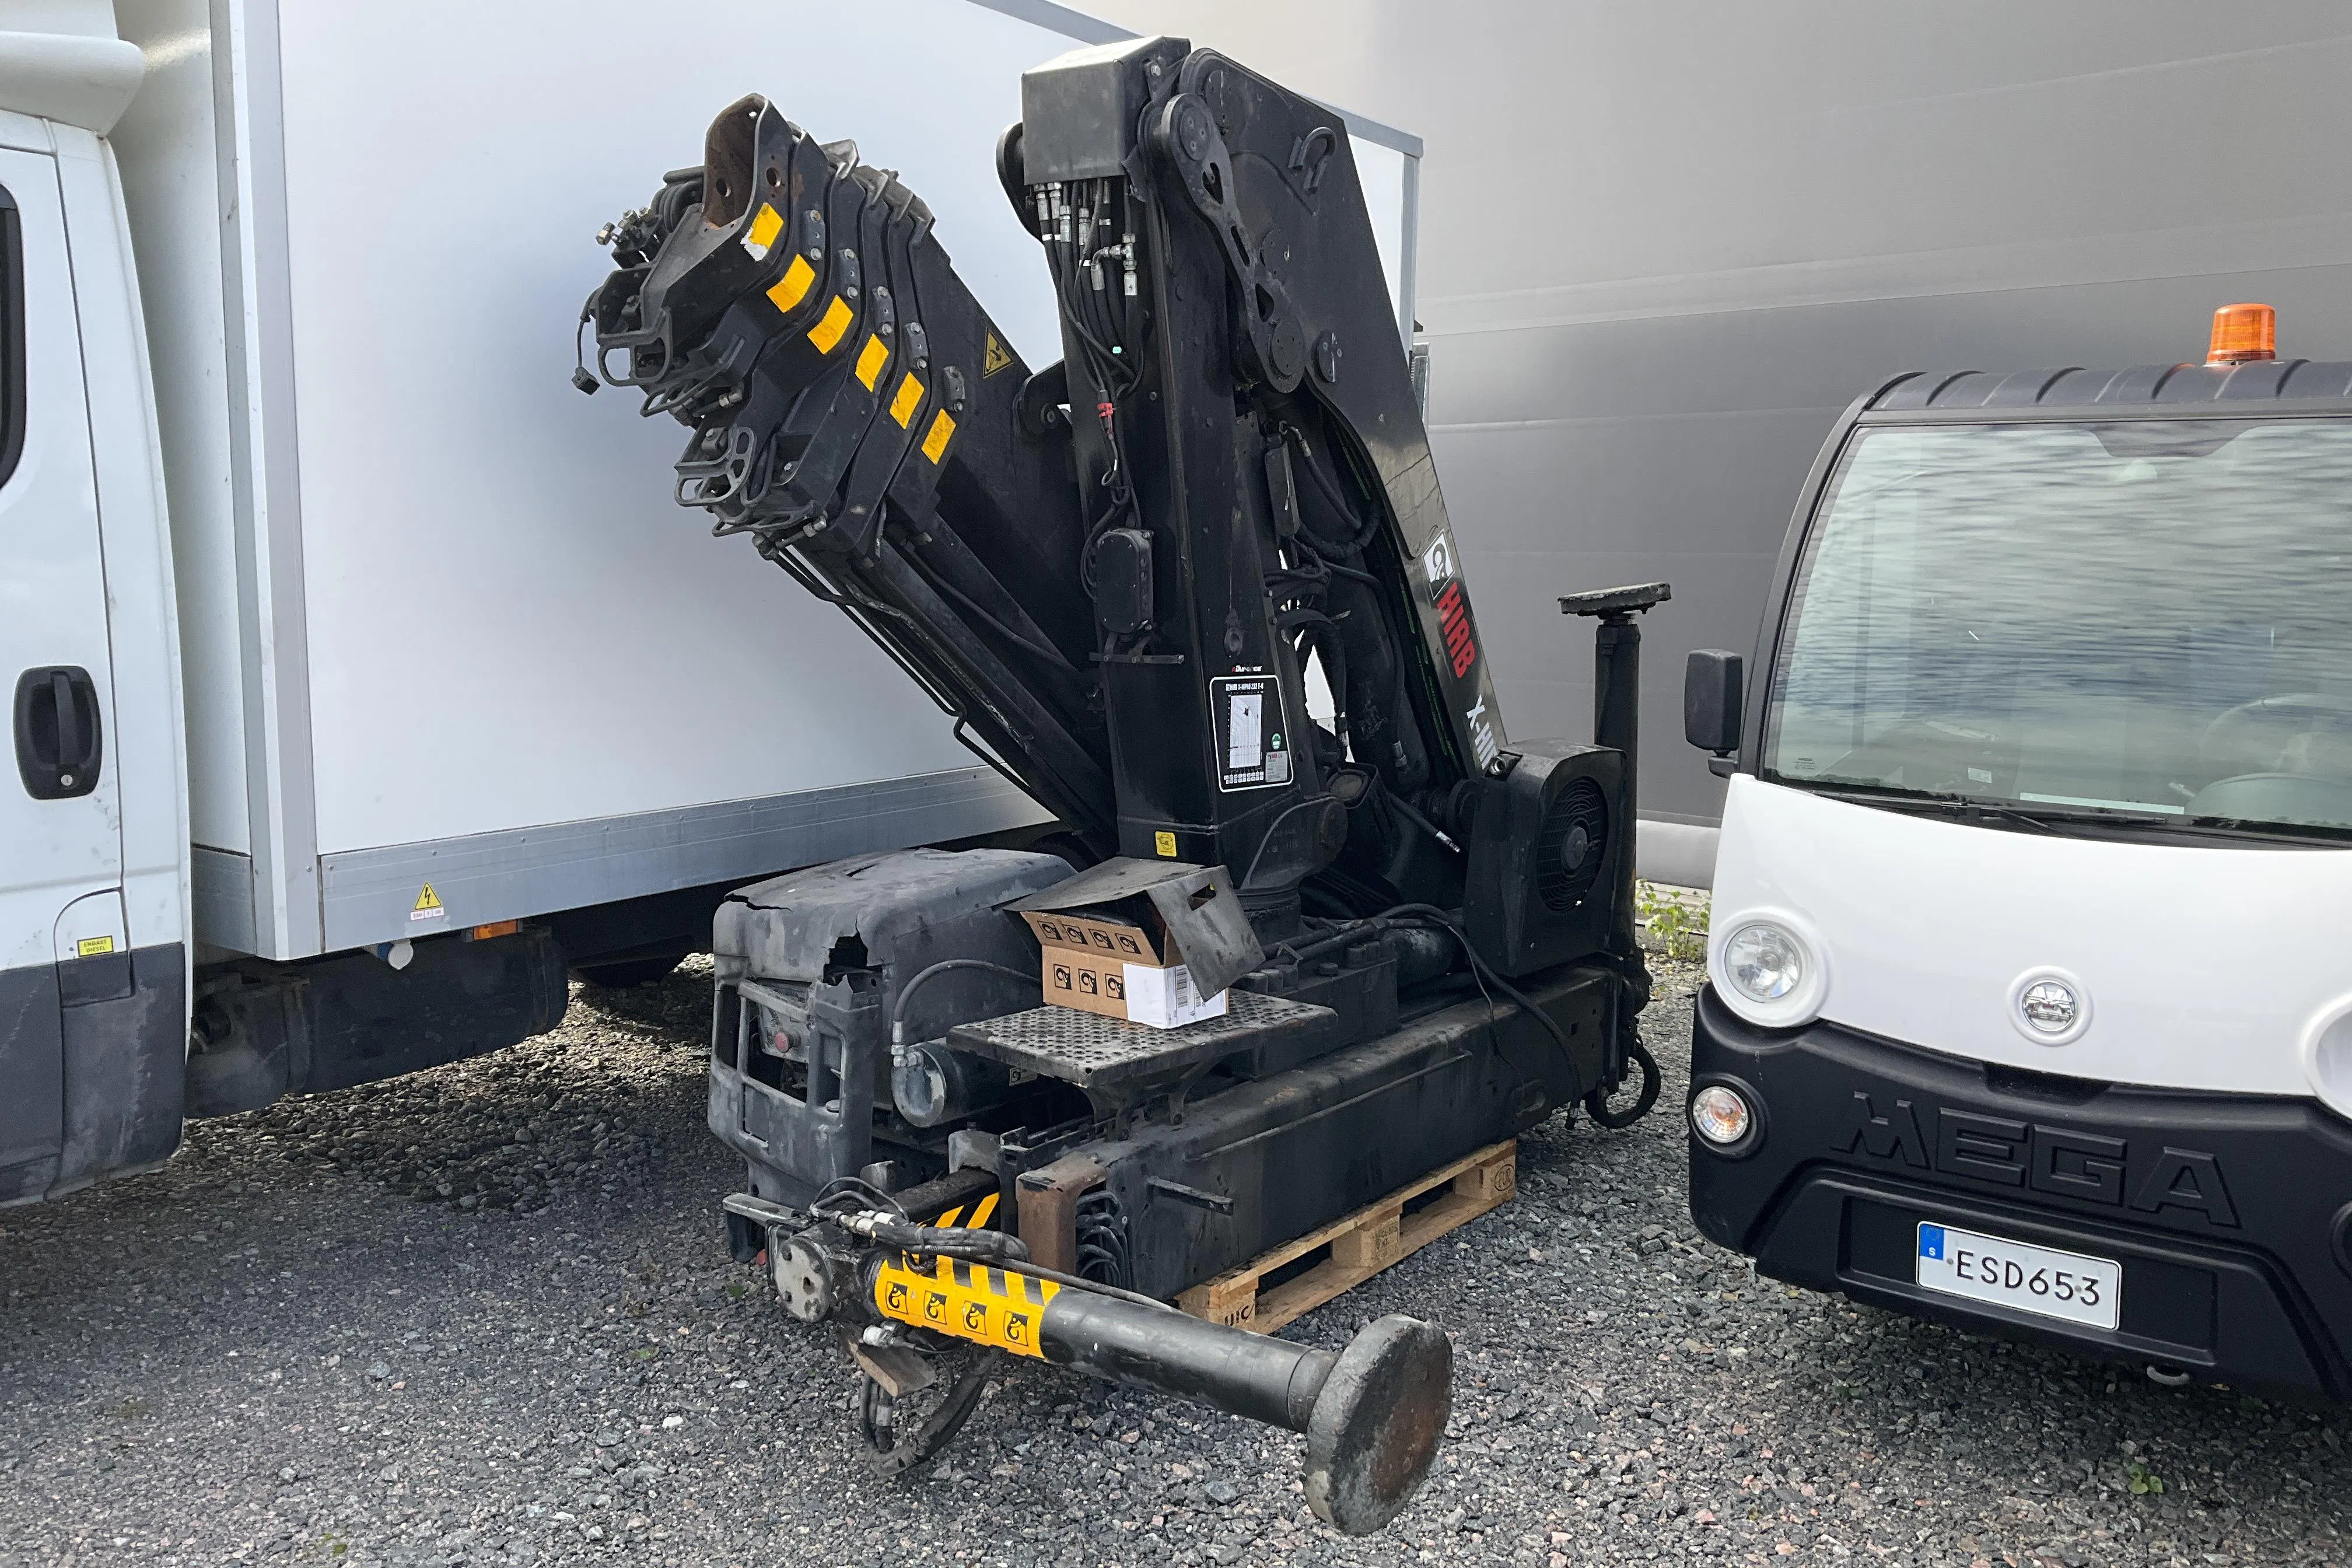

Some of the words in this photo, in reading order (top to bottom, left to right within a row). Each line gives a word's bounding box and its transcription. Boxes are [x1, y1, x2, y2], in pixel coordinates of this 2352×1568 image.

[1437, 581, 1475, 678] HIAB
[83, 939, 107, 947] ENDAST
[1829, 1091, 2242, 1230] MEGA
[1929, 1247, 1936, 1256] S
[1957, 1250, 2100, 1306] ESD653
